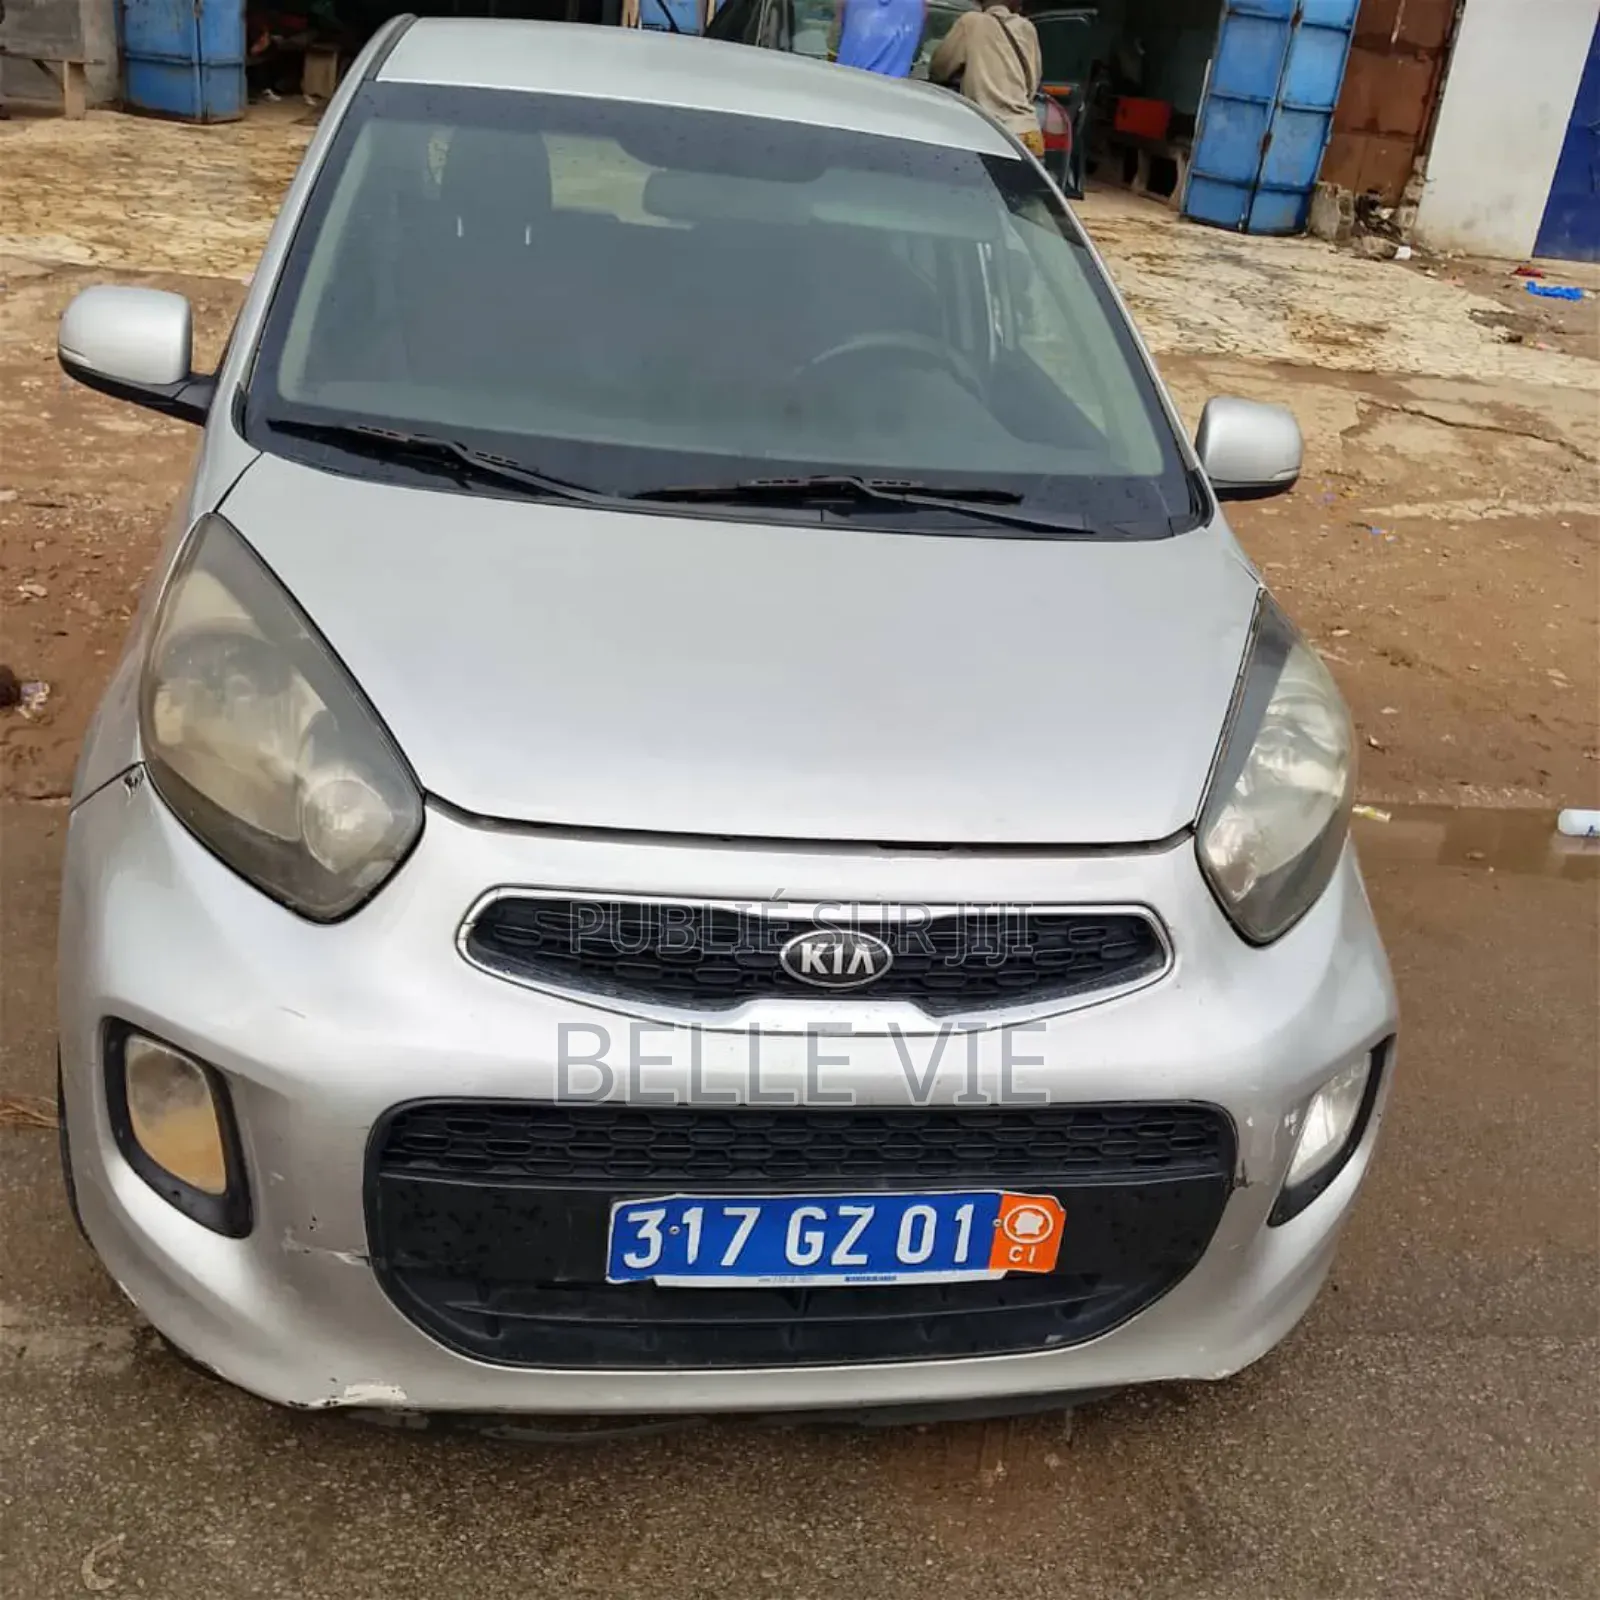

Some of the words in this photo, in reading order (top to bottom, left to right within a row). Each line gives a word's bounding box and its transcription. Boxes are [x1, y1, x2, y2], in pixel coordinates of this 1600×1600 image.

[801, 942, 875, 975] KIA
[622, 1207, 762, 1269] 317
[784, 1204, 875, 1267] GZ
[895, 1203, 975, 1265] 01
[1008, 1246, 1036, 1265] CI
